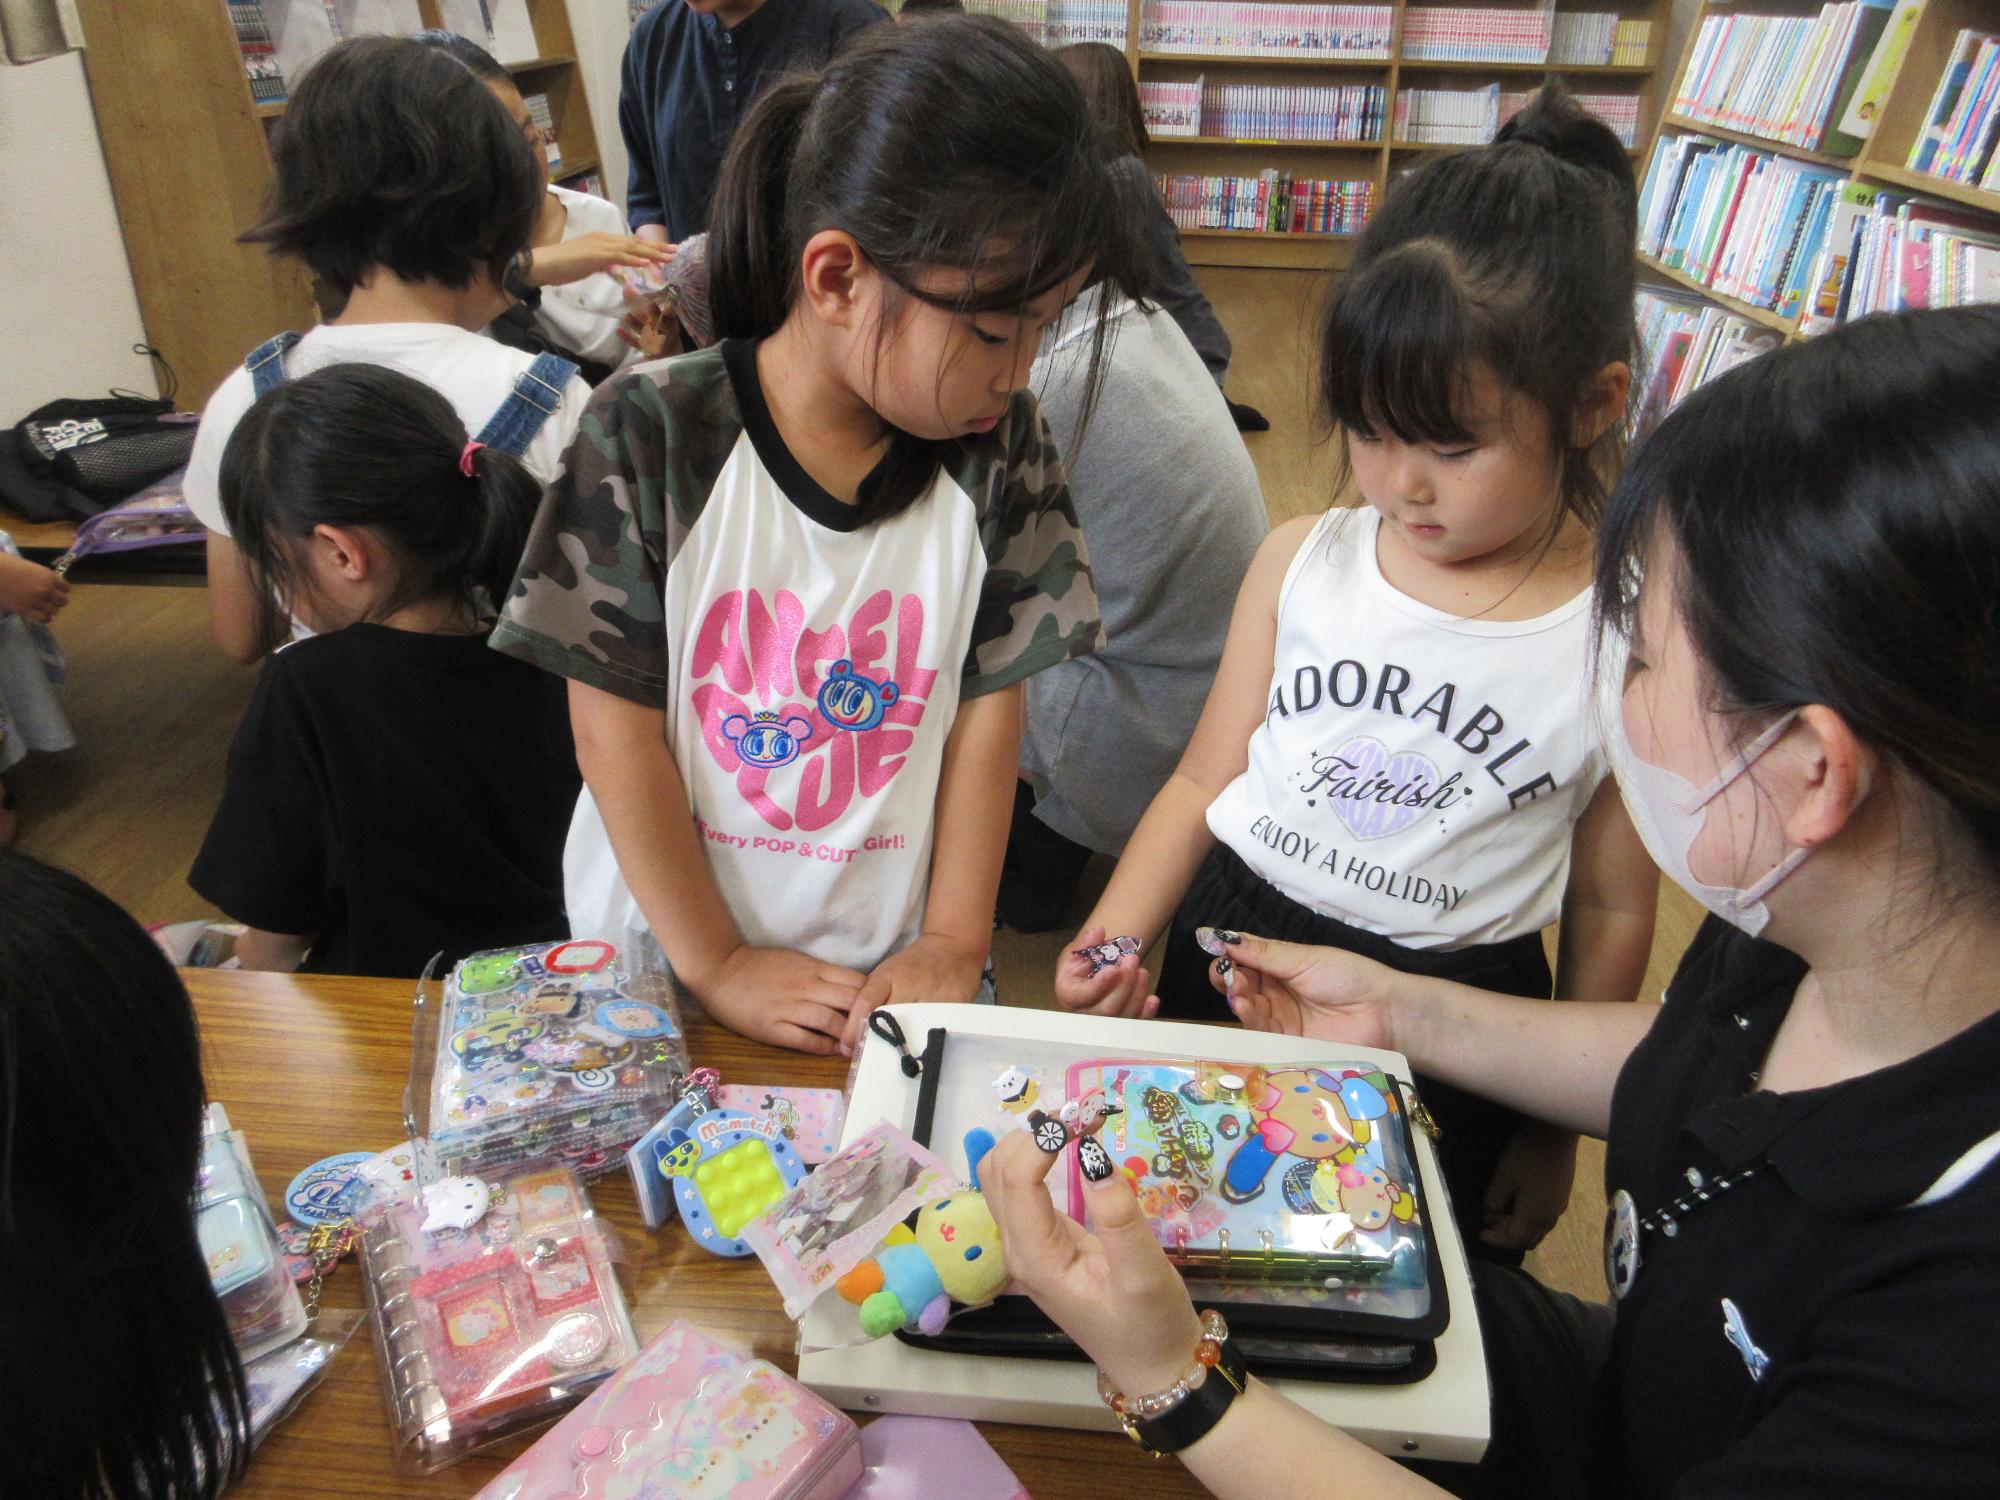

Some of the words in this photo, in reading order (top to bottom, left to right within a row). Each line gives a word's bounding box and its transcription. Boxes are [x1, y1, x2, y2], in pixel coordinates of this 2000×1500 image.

[1267, 659, 1557, 811] ADORABLE
[1300, 755, 1466, 810] Fairish
[753, 836, 795, 853] POP
[798, 842, 813, 857] &
[864, 833, 905, 851] Girl!
[1250, 815, 1320, 864] ENJOY
[1318, 848, 1338, 875] A
[1343, 856, 1468, 911] HOLIDAY
